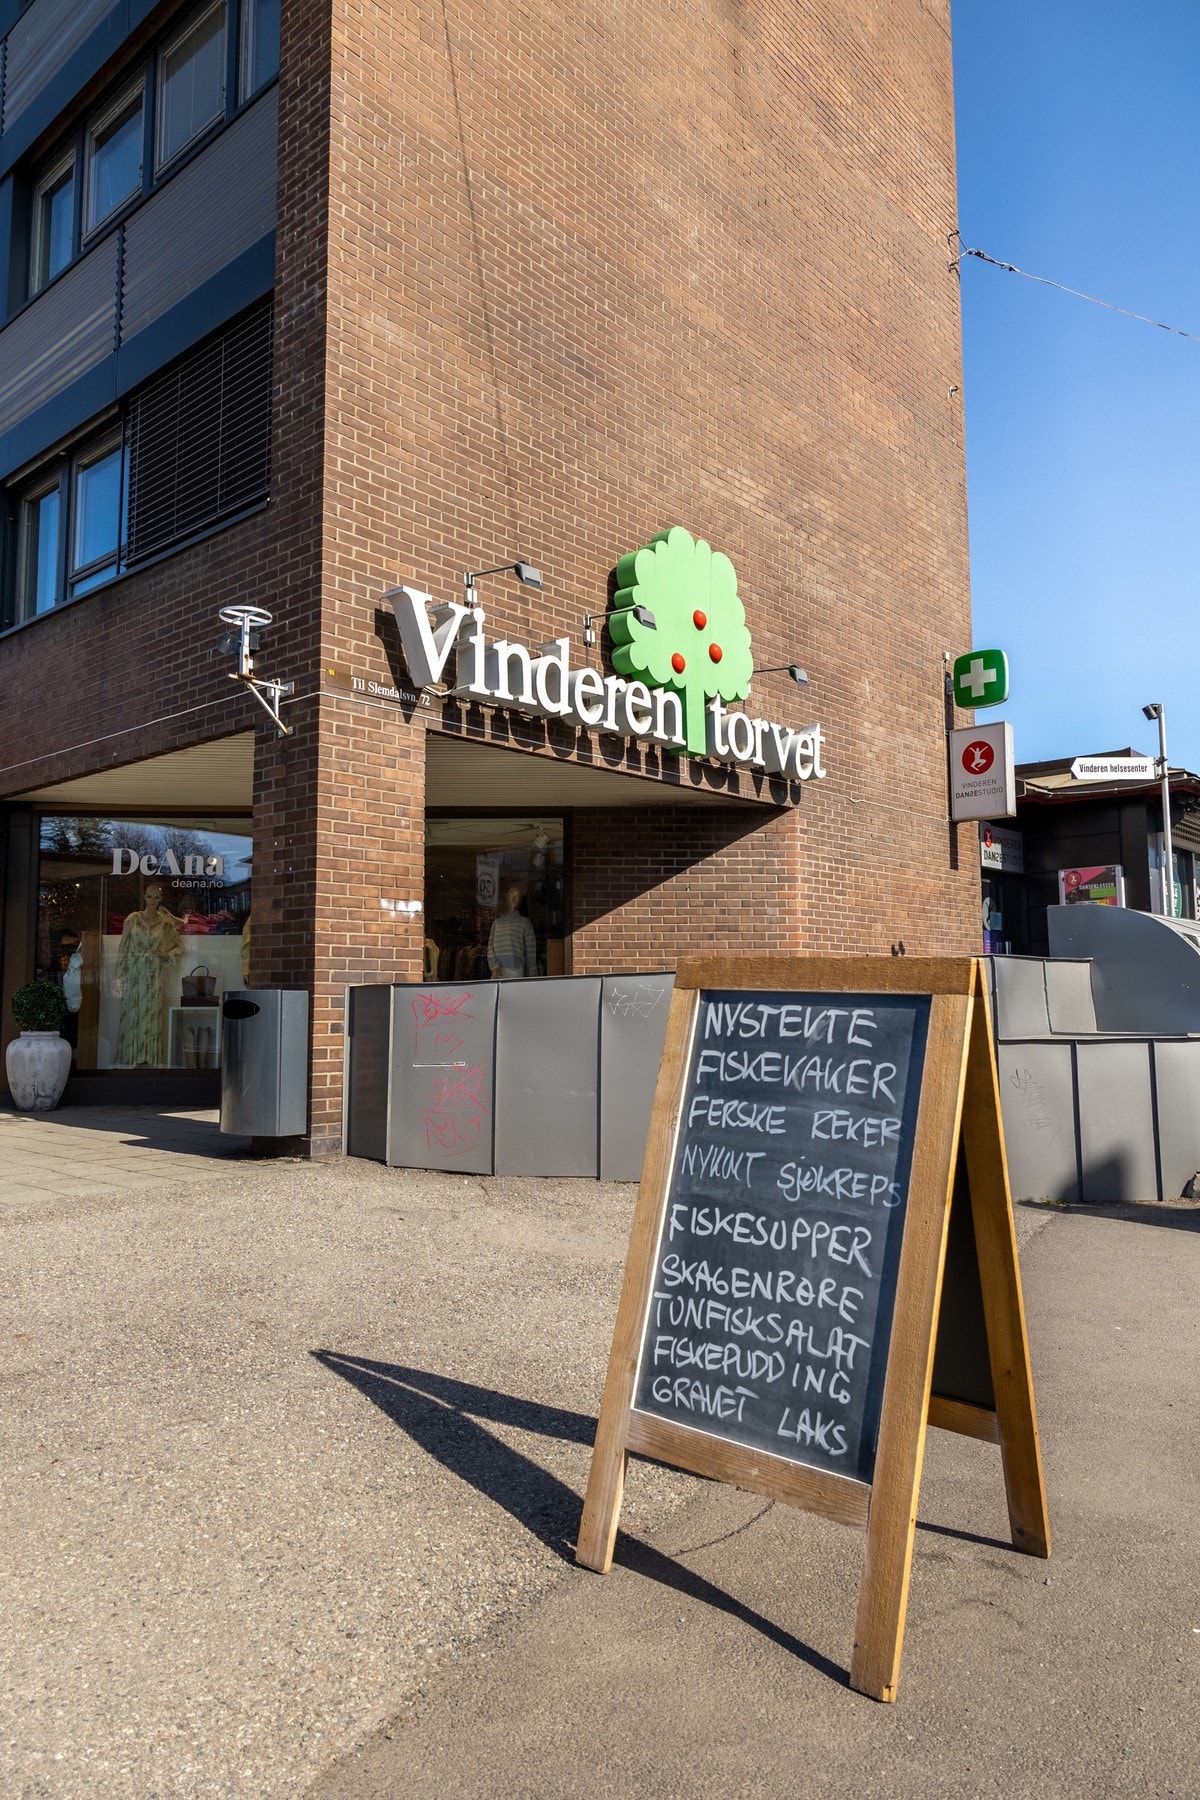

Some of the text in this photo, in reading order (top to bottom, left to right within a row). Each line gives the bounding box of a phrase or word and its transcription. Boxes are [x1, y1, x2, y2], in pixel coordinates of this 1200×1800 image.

[351, 676, 431, 706] Til Slemdalsvn. 72
[384, 585, 827, 781] Vinderen torvet
[955, 786, 1004, 799] DANSESTUDIO
[961, 779, 997, 789] VINDEREN
[1079, 763, 1148, 773] Vinderen helsesenter
[110, 847, 225, 876] DeAna
[171, 879, 224, 889] deana.no
[696, 1049, 897, 1104] FISKEKAKER
[688, 1096, 904, 1148] FERSKE REKER
[669, 1204, 873, 1278] FISKESUPPER
[661, 1253, 864, 1324] SKAGENRØRE
[653, 1291, 870, 1370] TUNFISKSALAT
[651, 1375, 848, 1455] GRAVET LAKS
